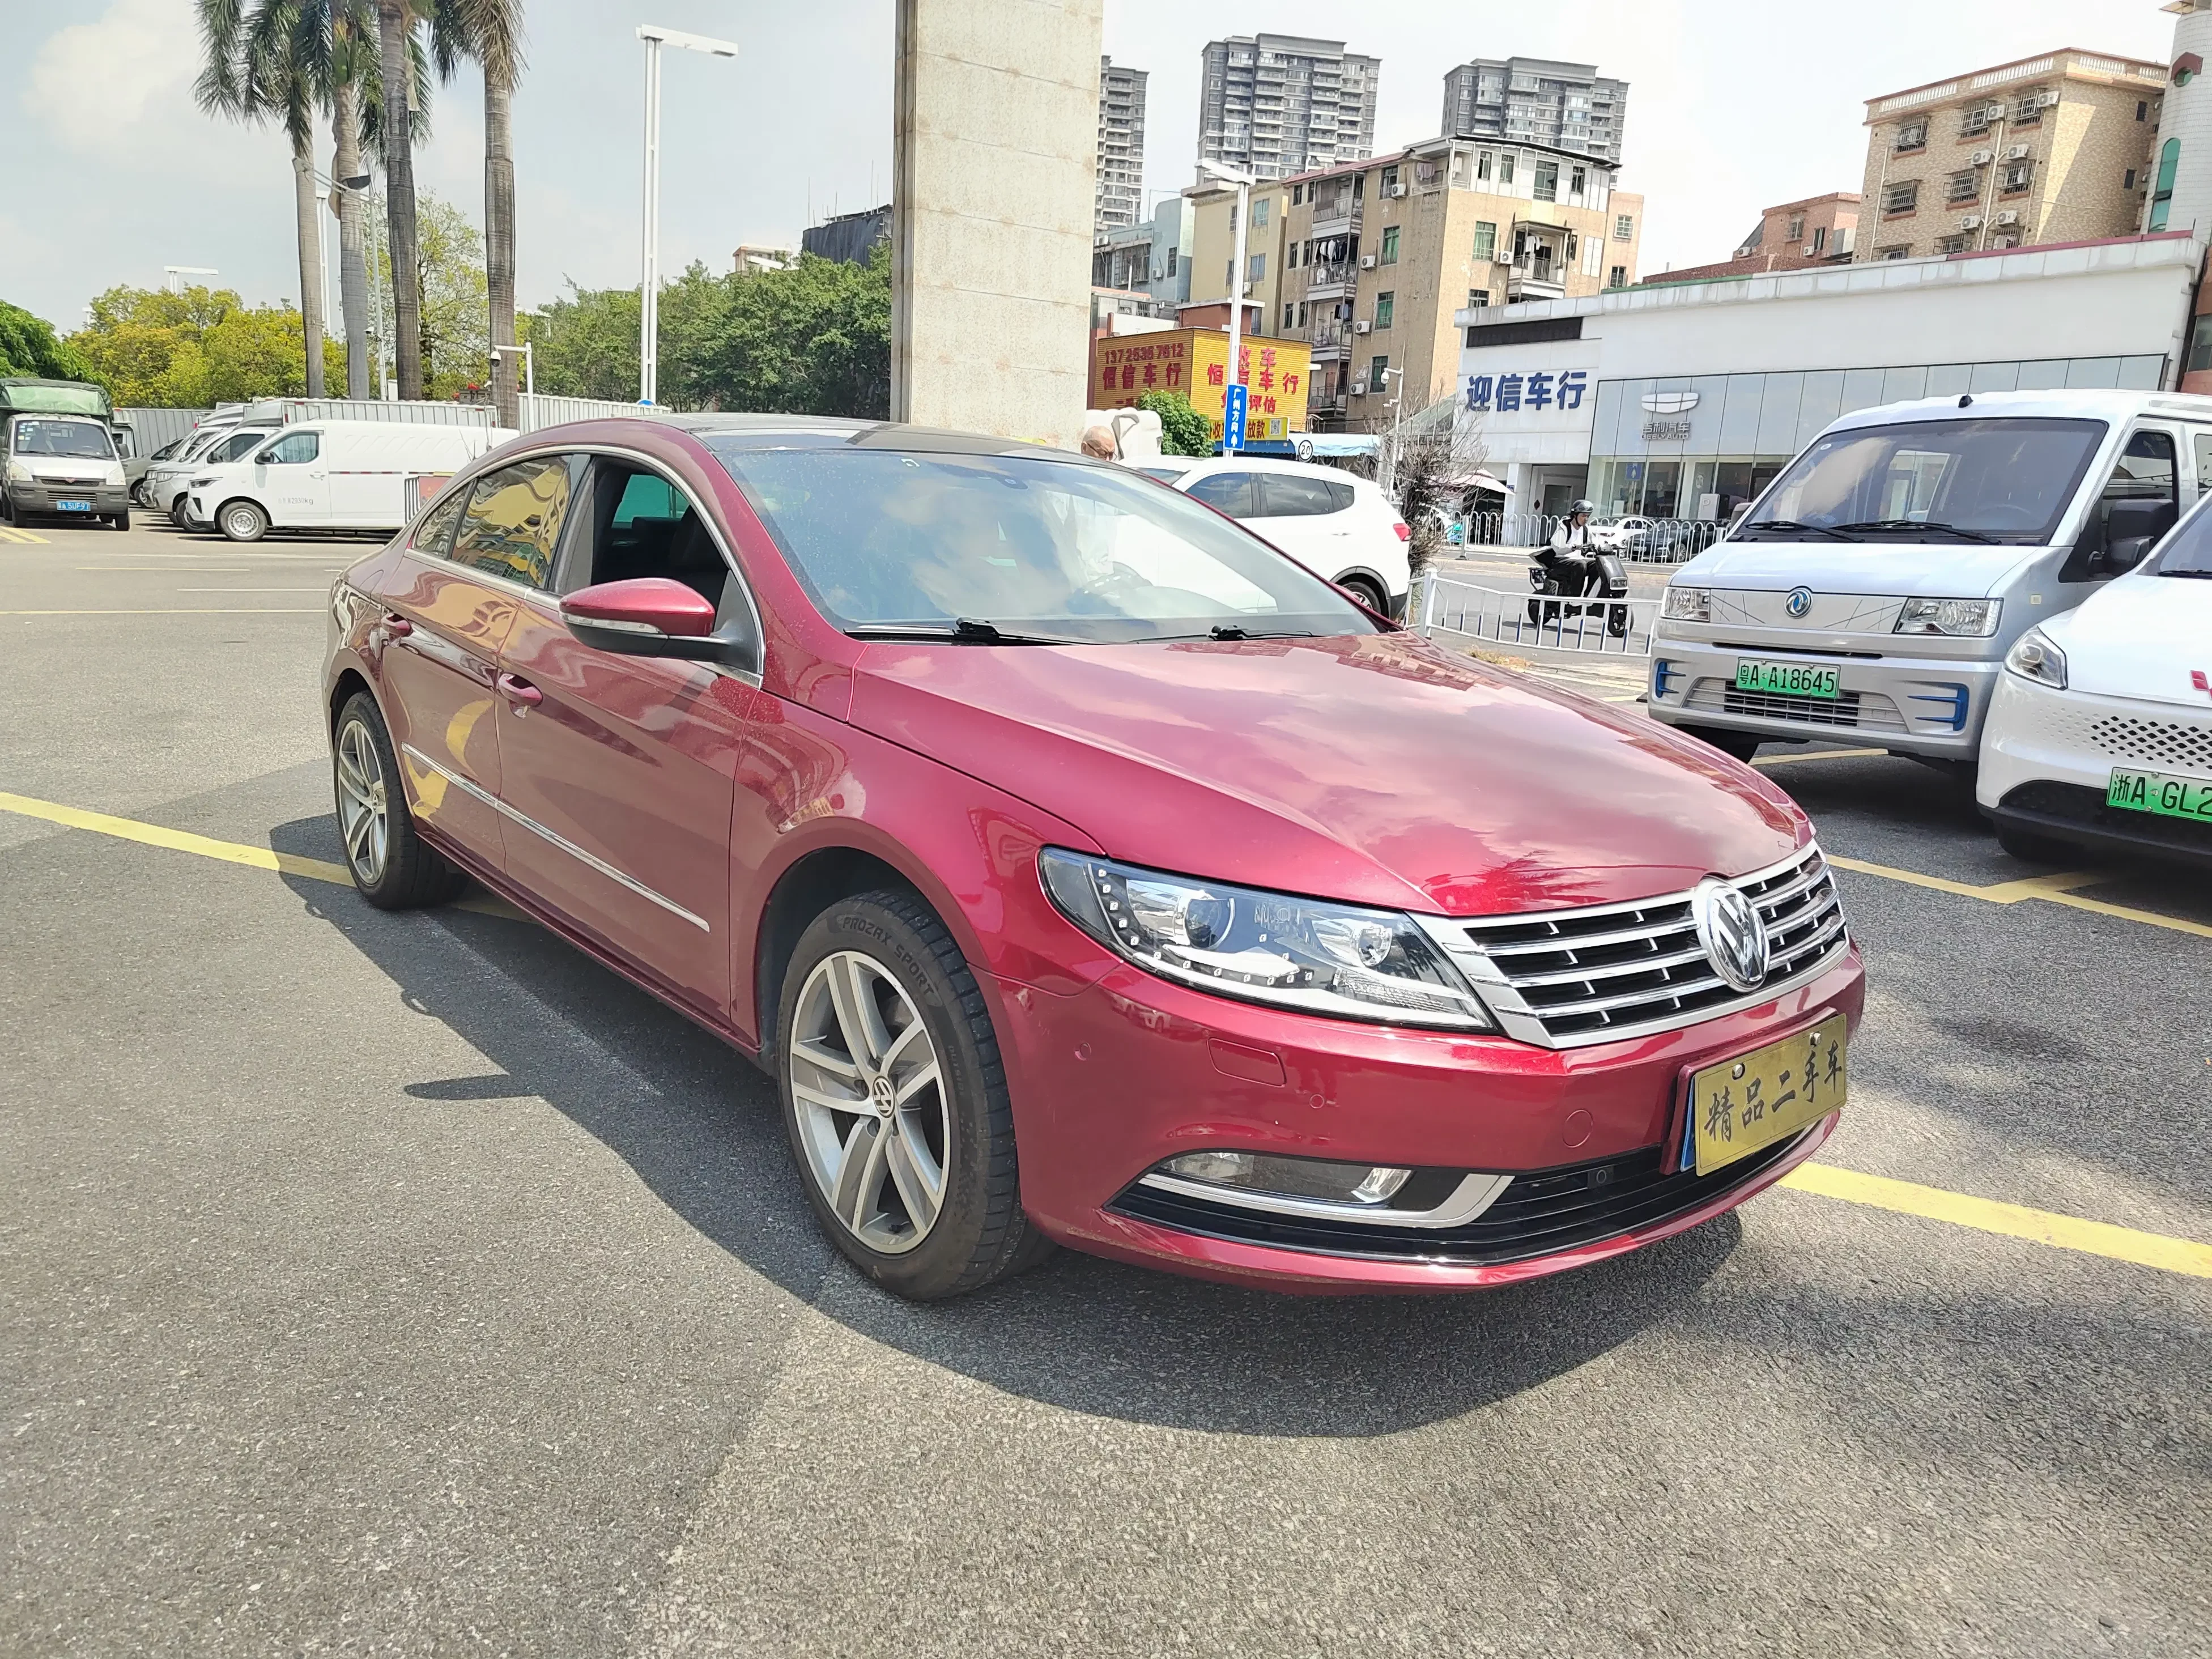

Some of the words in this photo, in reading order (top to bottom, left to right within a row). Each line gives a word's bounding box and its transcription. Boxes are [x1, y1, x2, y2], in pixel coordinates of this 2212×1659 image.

[1103, 361, 1182, 390] 恒信车行
[1465, 370, 1587, 412] 迎信车行
[1231, 387, 1241, 432] 广州方向
[1643, 421, 1691, 433] 吉利汽车
[1301, 445, 1311, 455] 20
[894, 943, 935, 994] SPORT
[1704, 1039, 1843, 1143] 精品二手车
